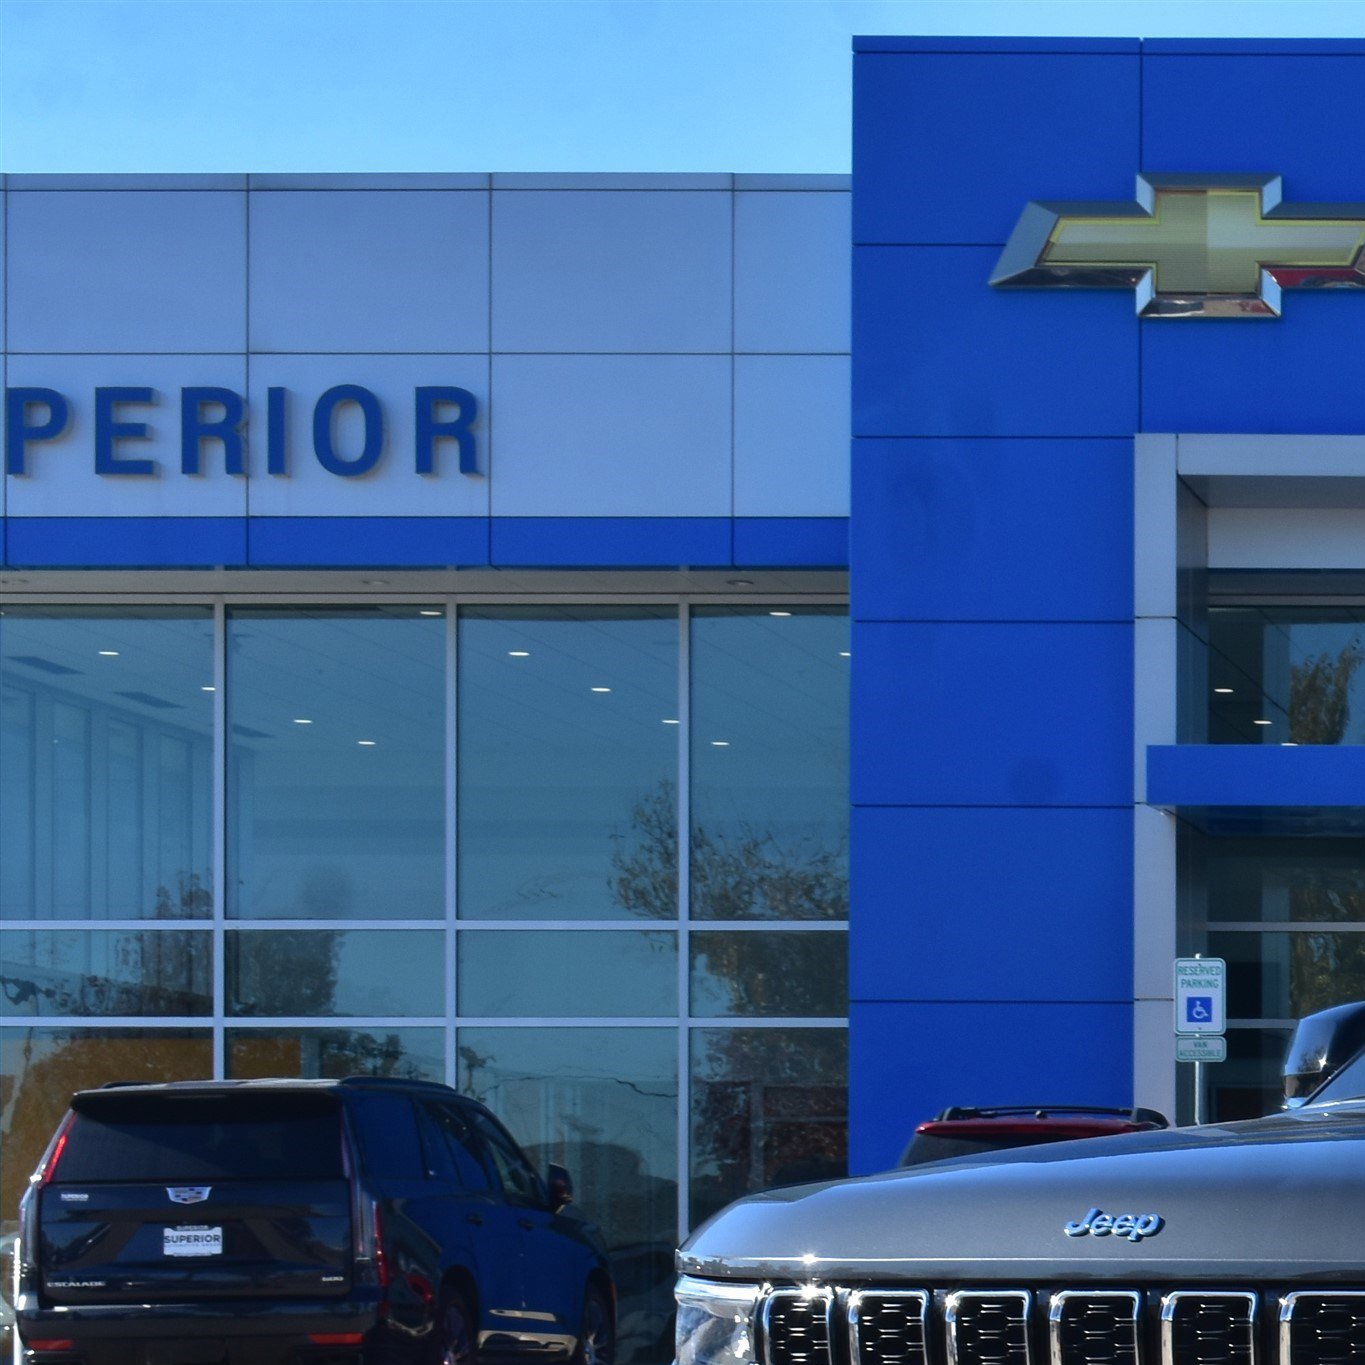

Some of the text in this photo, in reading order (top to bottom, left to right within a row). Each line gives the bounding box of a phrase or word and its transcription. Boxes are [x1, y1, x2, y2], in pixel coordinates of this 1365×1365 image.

[5, 383, 485, 478] PERIOR
[1177, 966, 1222, 976] RESERVED
[1180, 978, 1220, 989] PARKING
[1193, 1041, 1208, 1049] VAN
[1064, 1207, 1164, 1242] Jeep
[163, 1234, 221, 1244] SUPERIOR
[47, 1280, 106, 1288] ESCALADE
